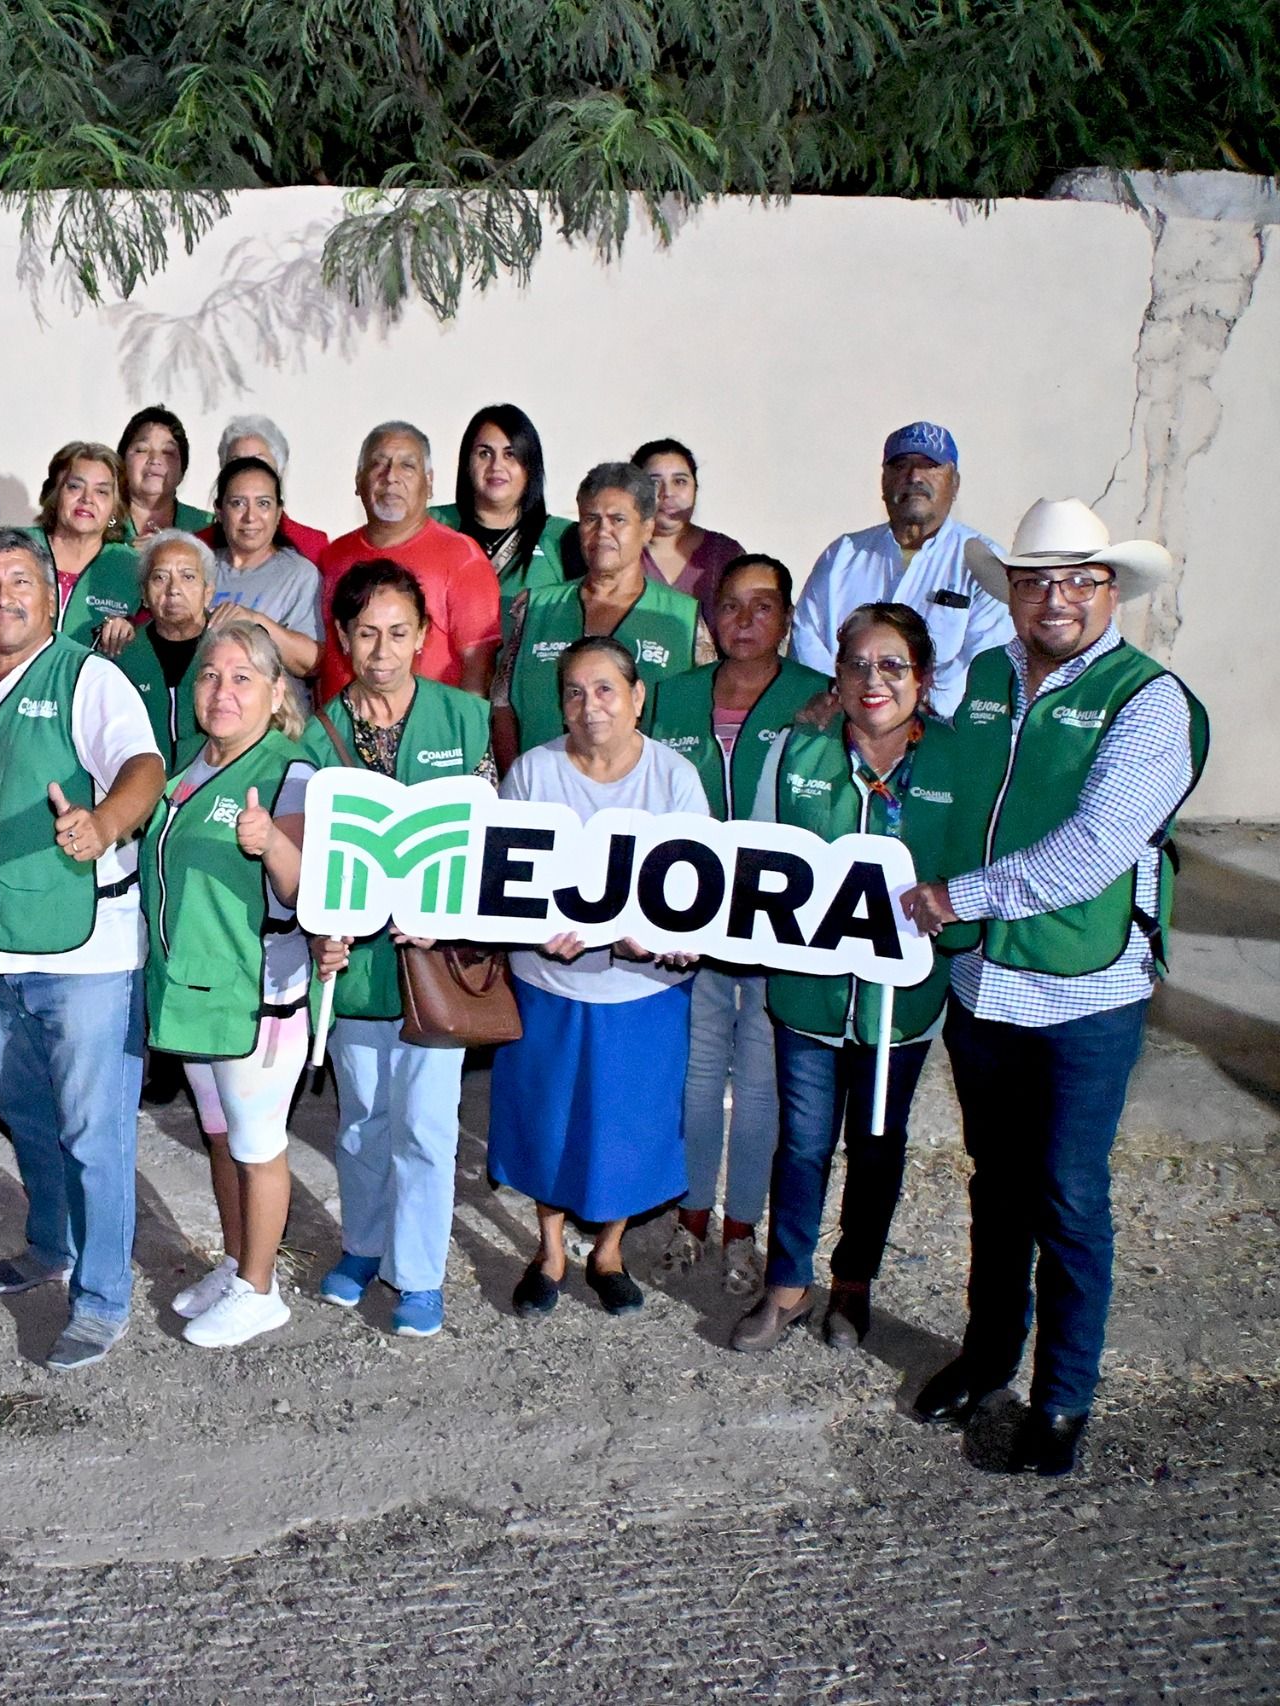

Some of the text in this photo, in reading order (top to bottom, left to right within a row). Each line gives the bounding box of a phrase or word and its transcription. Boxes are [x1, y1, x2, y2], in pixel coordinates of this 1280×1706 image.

[85, 595, 129, 610] COAHUILA
[416, 748, 463, 764] COAHUIL
[787, 773, 832, 791] MEJORA
